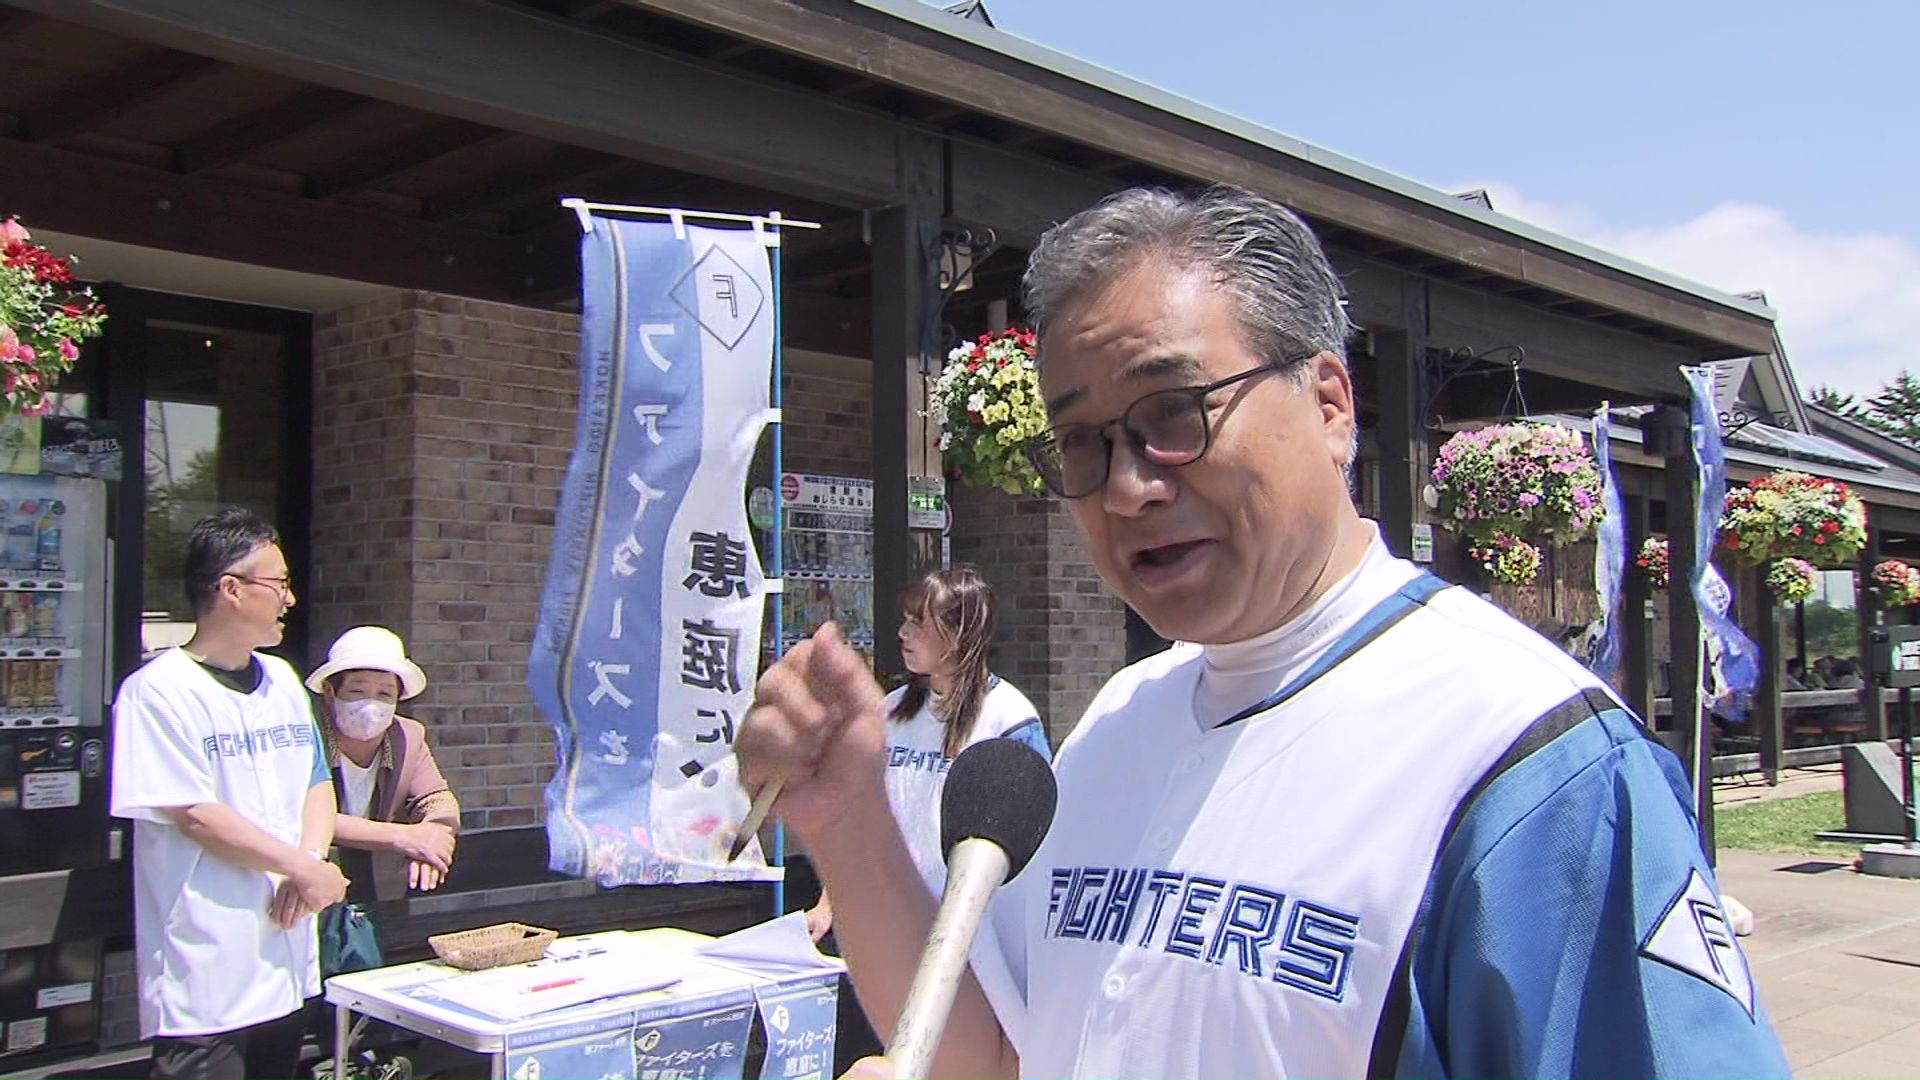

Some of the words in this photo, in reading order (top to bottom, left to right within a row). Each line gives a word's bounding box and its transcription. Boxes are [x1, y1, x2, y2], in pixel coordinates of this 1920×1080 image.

[1045, 865, 1361, 1004] FIGHTERS
[1687, 898, 1733, 985] F
[775, 1023, 836, 1056] ファイターズ
